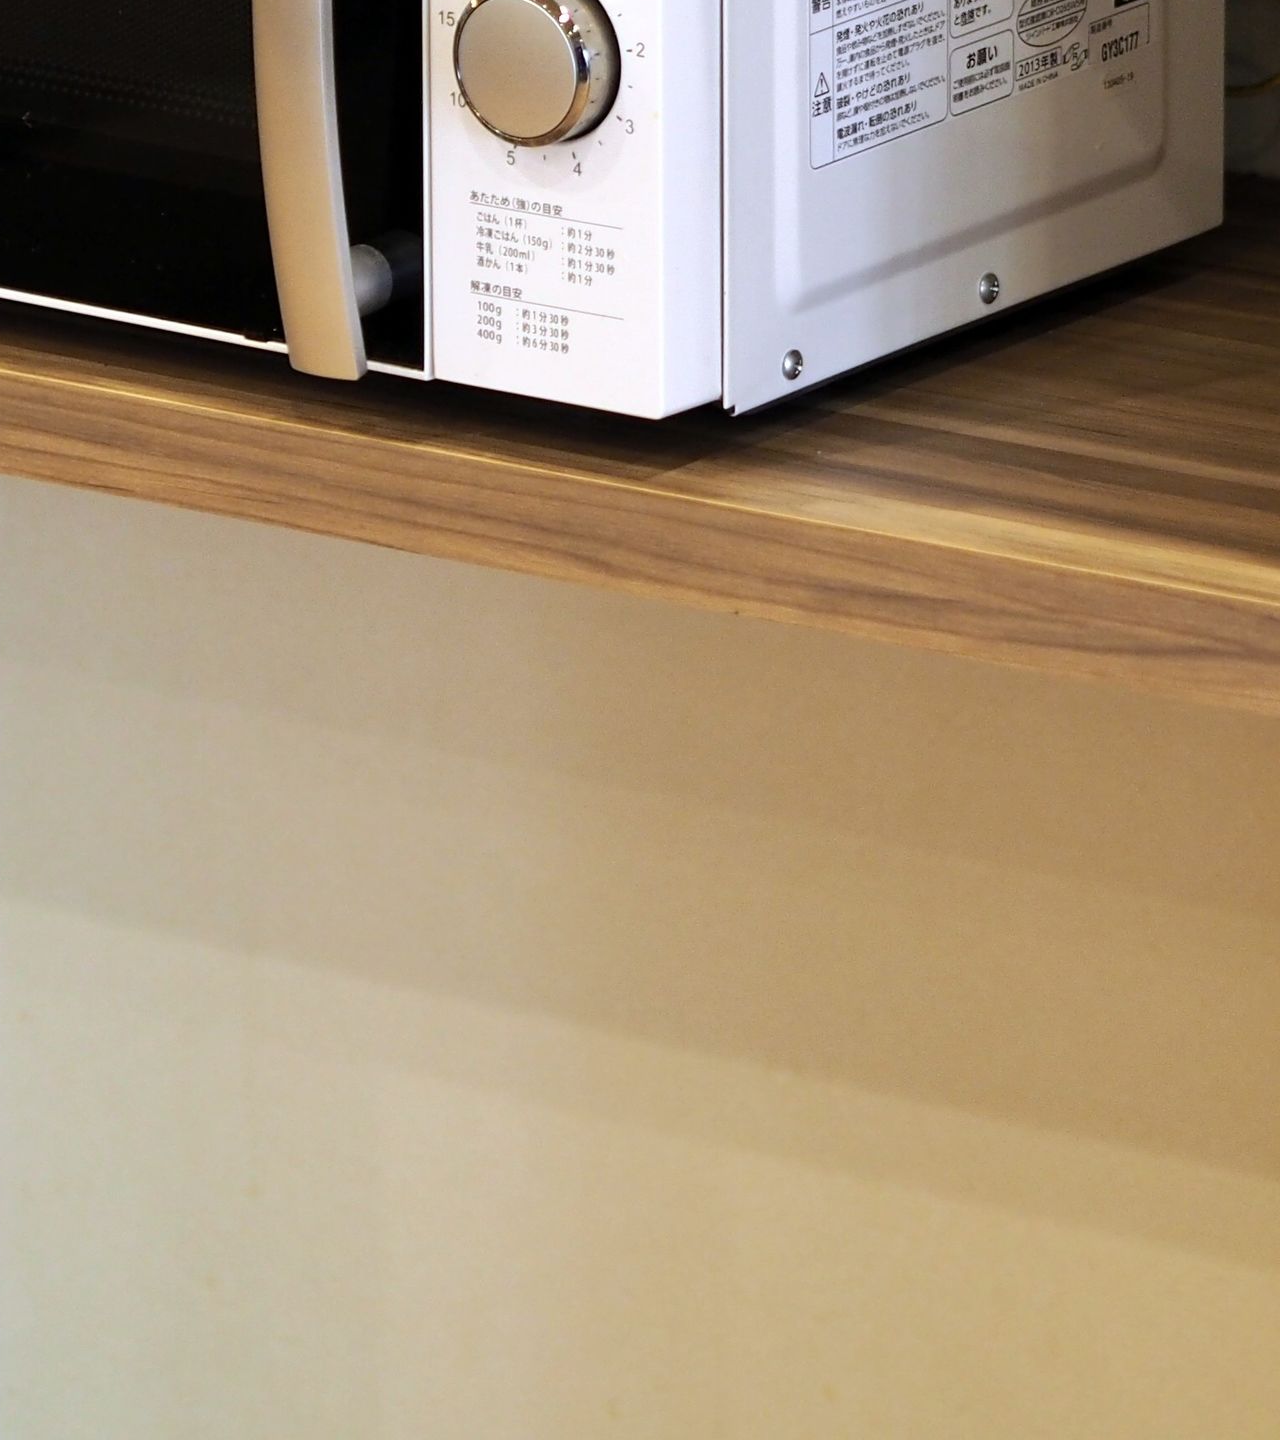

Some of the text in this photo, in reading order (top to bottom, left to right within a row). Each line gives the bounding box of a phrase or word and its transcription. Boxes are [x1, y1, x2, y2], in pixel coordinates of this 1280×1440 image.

[438, 11, 455, 26] 15
[635, 43, 646, 58] 2
[966, 44, 998, 70] お願い
[1018, 50, 1058, 78] 2013年製
[450, 92, 467, 108] 10
[812, 96, 832, 118] 注意
[625, 118, 635, 135] 3
[506, 150, 516, 166] 5
[573, 162, 583, 177] 4
[469, 190, 563, 217] あたため(強)の目安
[470, 280, 523, 299] 解凍の目安
[477, 301, 502, 317] 100g
[477, 315, 502, 330] 200g
[477, 328, 503, 345] 400g
